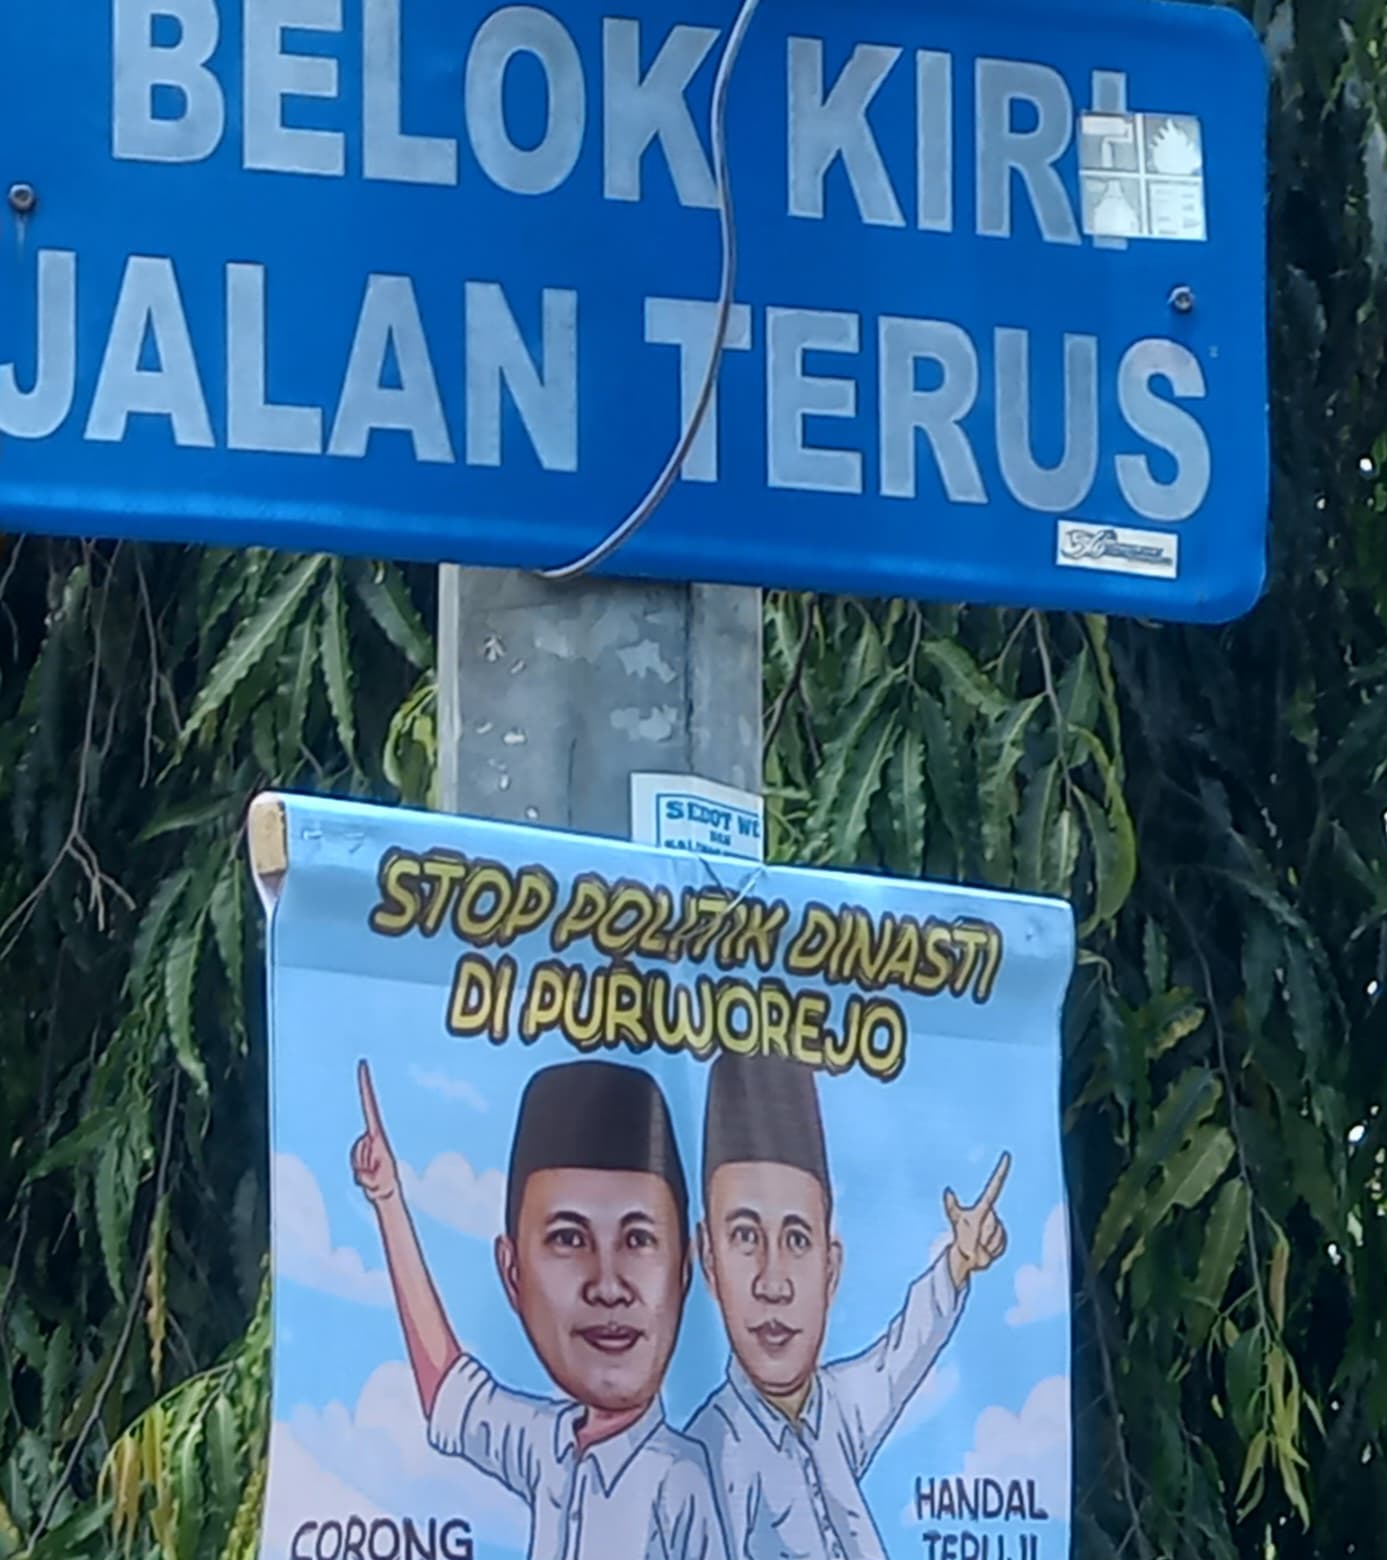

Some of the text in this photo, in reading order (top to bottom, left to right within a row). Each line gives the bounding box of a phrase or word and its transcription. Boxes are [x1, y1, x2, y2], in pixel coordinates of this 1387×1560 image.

[112, 0, 719, 210] BELOK
[0, 248, 1213, 521] JALAN TERUS
[369, 846, 1005, 1002] STOP POLITIK DINASTI
[446, 955, 907, 1080] DI PURWOREJO
[914, 1476, 1049, 1525] HANDAL
